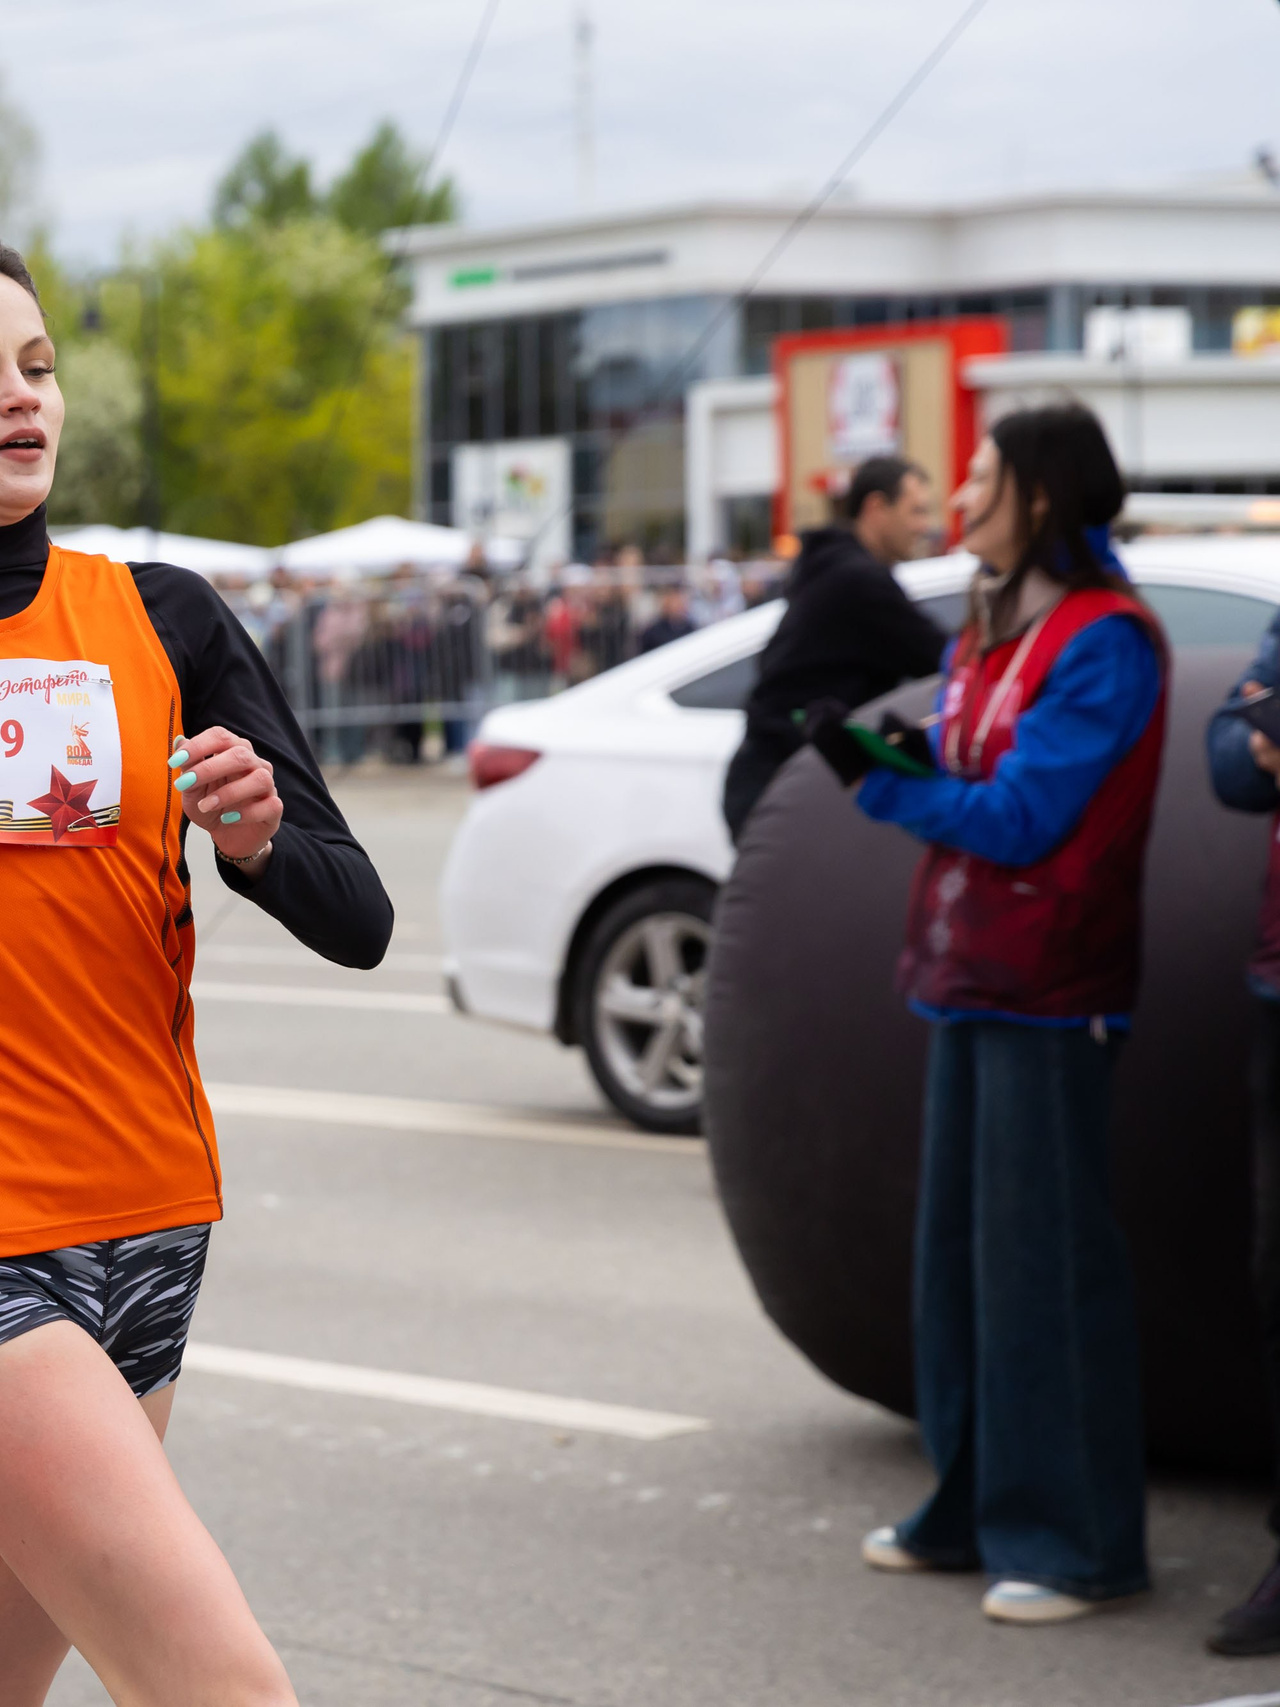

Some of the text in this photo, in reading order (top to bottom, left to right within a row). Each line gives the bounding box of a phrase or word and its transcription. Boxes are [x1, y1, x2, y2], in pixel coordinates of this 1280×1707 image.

[56, 692, 91, 706] МИРА
[0, 719, 24, 758] 9
[66, 745, 80, 756] 80
